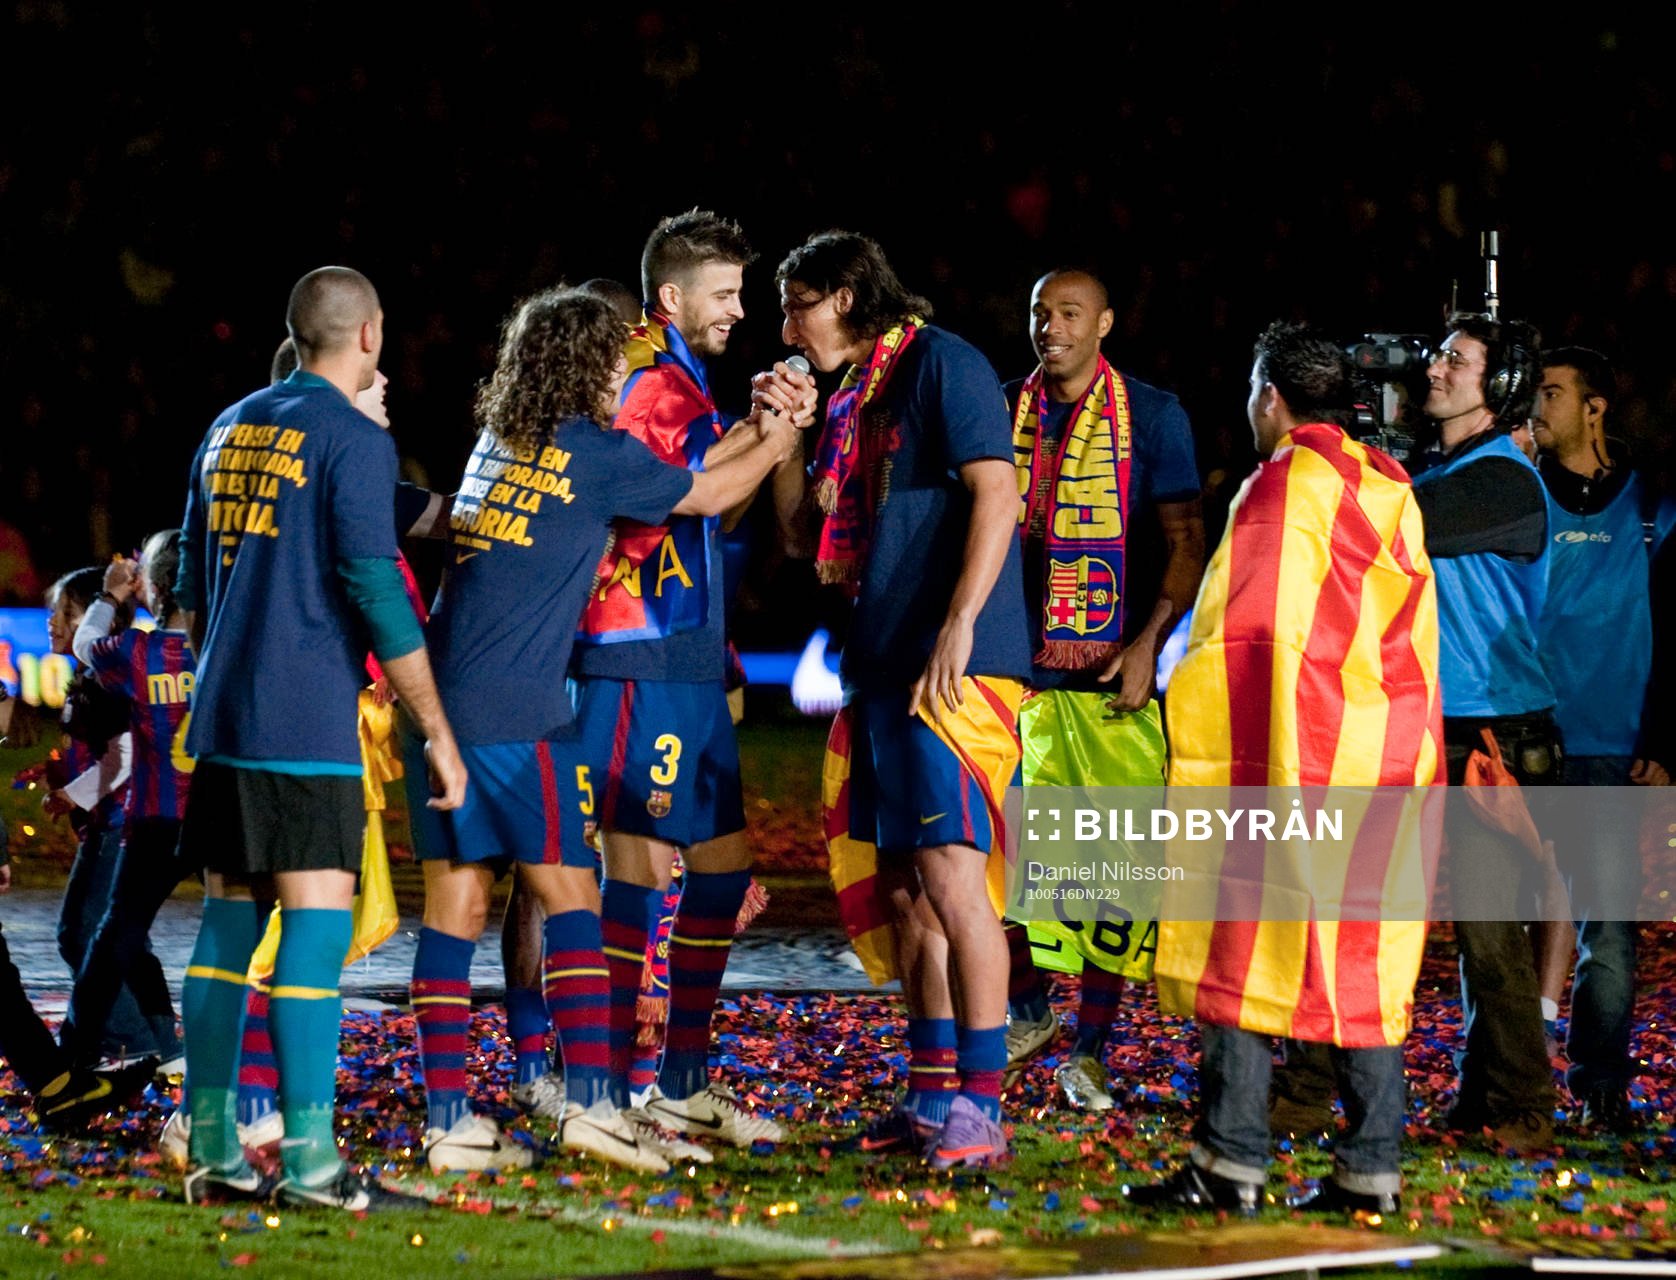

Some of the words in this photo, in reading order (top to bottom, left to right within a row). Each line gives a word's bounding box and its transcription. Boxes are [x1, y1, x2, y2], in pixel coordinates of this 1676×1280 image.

[275, 428, 306, 455] EN
[537, 445, 572, 474] EN
[487, 482, 518, 505] EN
[513, 489, 542, 514] LA
[650, 733, 682, 786] 3
[576, 765, 595, 815] 5
